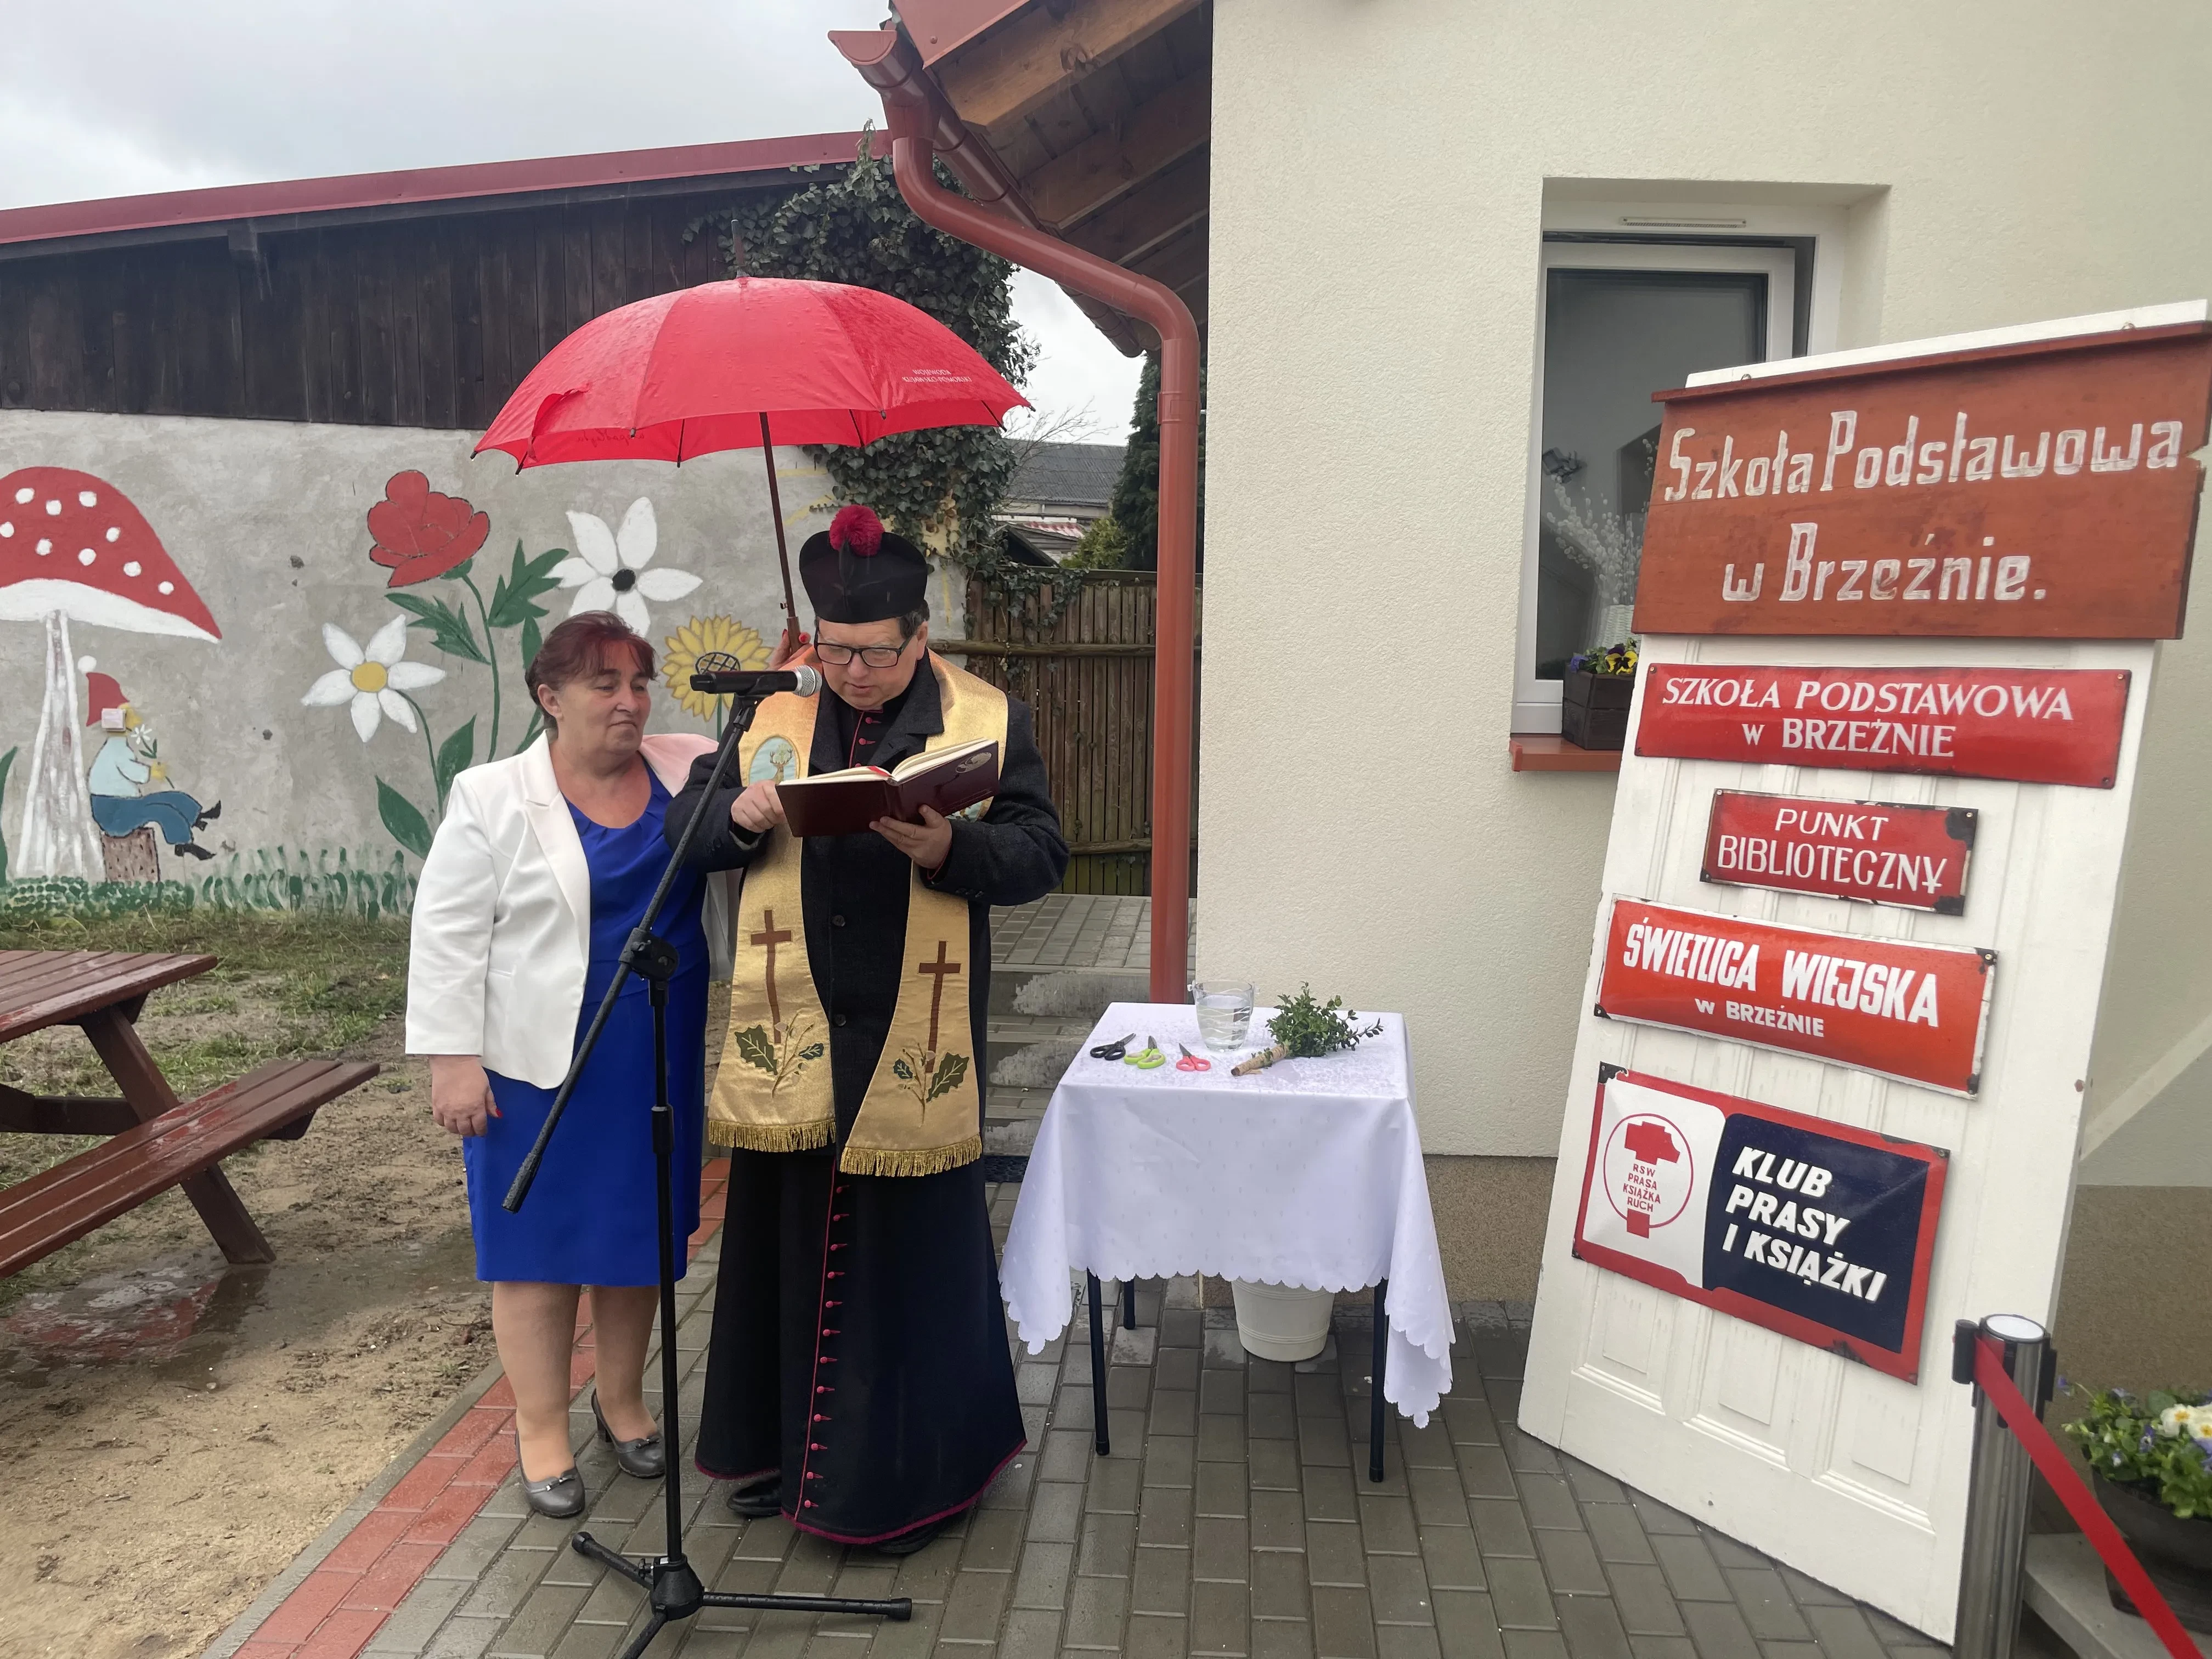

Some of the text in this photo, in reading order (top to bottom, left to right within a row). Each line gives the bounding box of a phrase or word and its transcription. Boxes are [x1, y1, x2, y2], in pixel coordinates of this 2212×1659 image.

[1664, 410, 2183, 501] Szkoła Podstawowa
[1722, 562, 1764, 602] w
[1662, 678, 2074, 720] SZKOŁA PODSTAWOWA
[1775, 808, 1889, 841] PUNKT
[1623, 917, 1939, 1028] ŚWIETLICA WIEJSKA
[1628, 1172, 1657, 1190] PRASA
[1633, 1164, 1656, 1177] RSW
[1732, 1146, 1833, 1198] KLUB
[1623, 1183, 1661, 1204] KSIĄŻKA
[1627, 1196, 1654, 1212] RUCH
[1725, 1184, 1850, 1246] PRASY
[1722, 1223, 1887, 1304] I KSIĄŻKI
